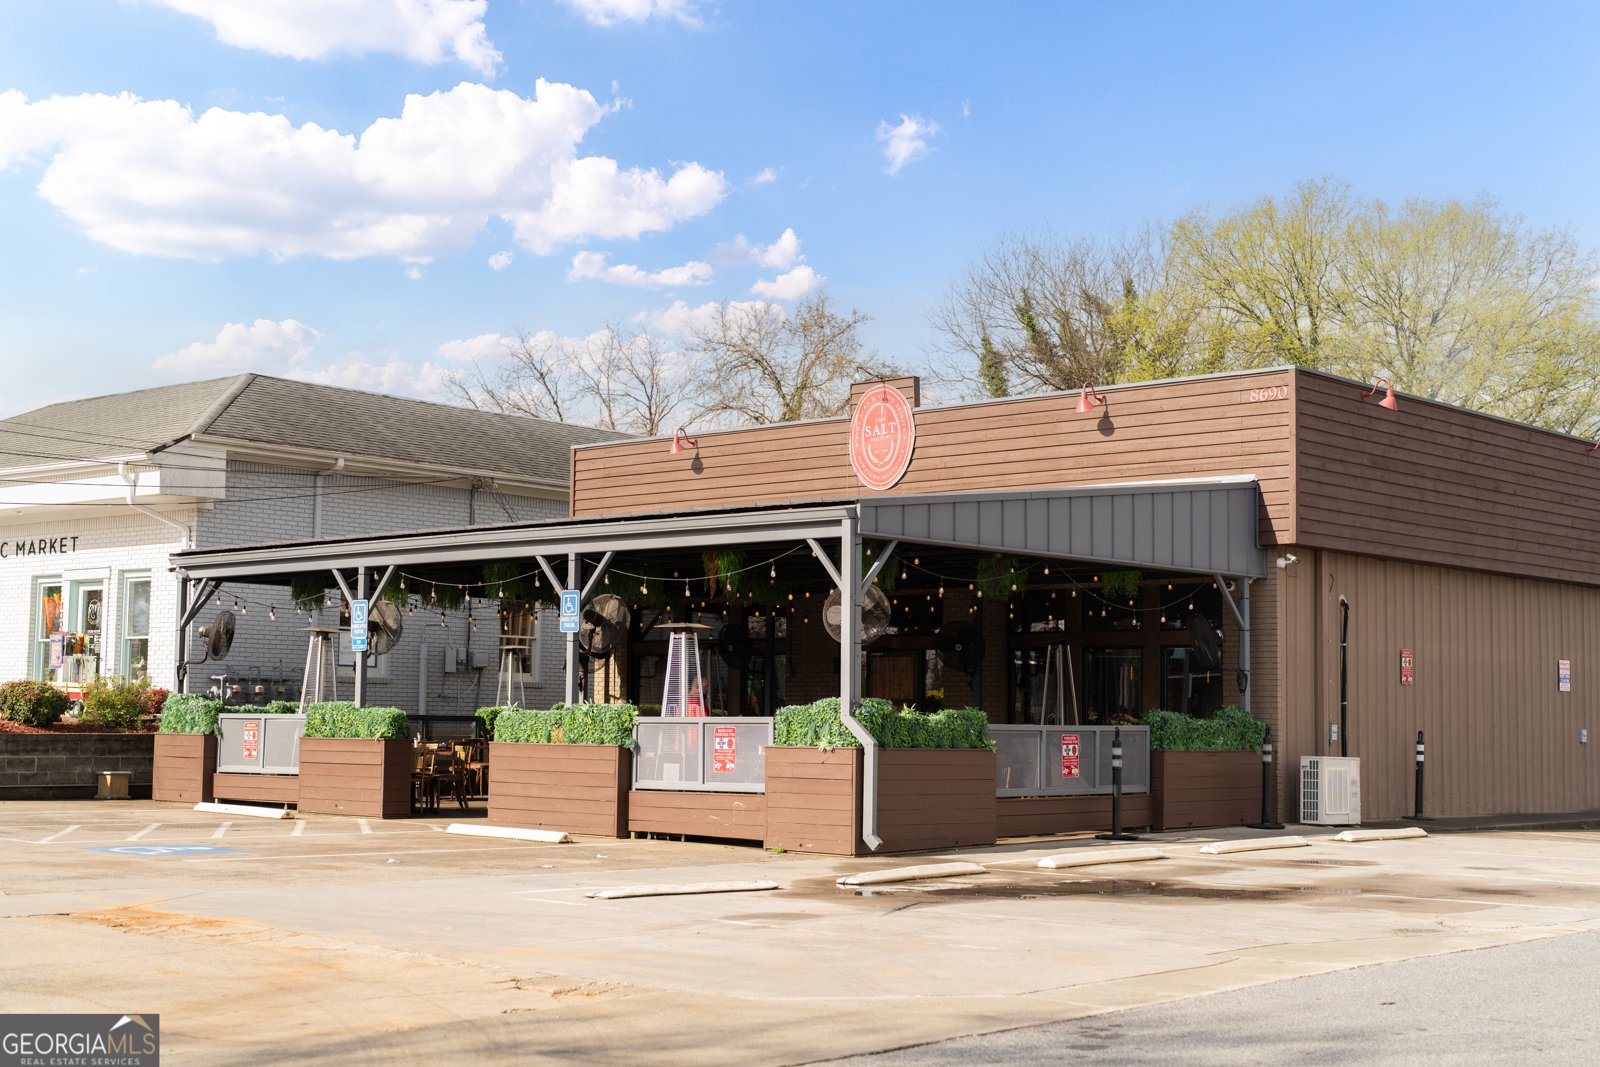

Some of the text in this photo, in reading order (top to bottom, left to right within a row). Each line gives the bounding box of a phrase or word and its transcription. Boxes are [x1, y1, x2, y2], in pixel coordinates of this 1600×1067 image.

[1249, 386, 1287, 402] 8690
[865, 421, 896, 437] SALT
[0, 536, 79, 558] C MARKET
